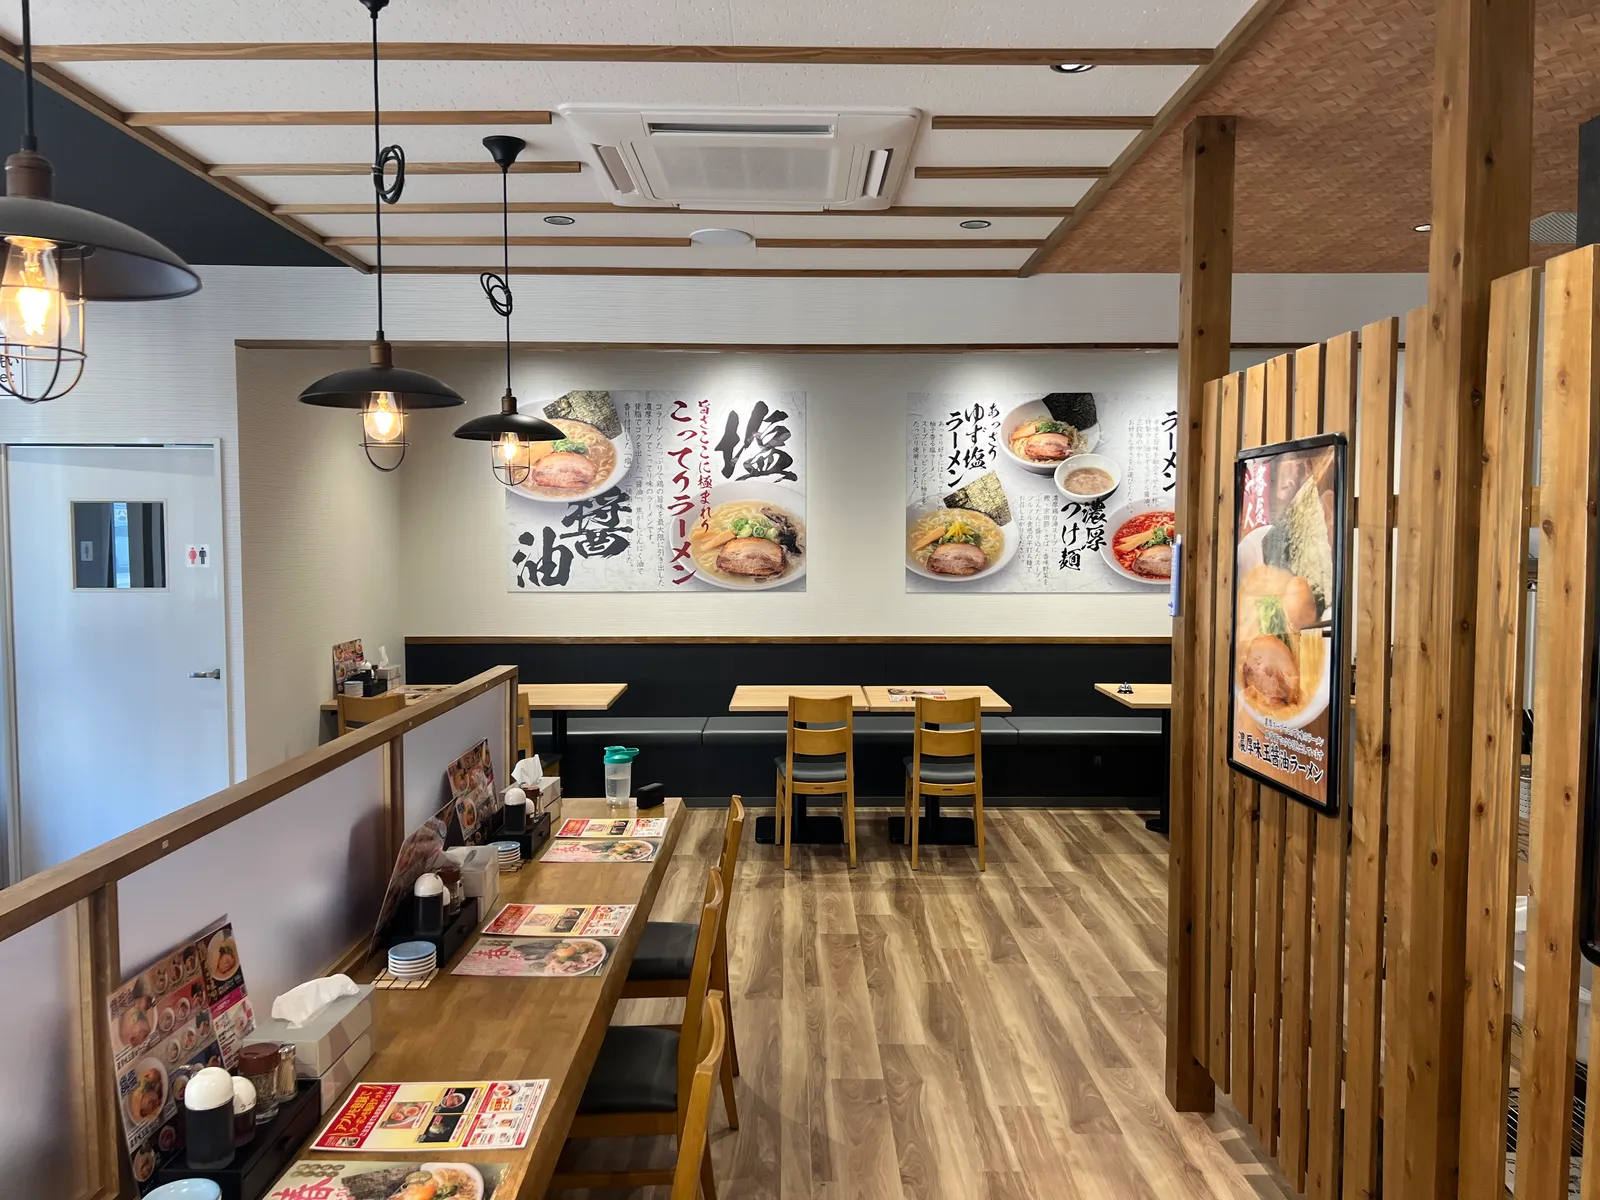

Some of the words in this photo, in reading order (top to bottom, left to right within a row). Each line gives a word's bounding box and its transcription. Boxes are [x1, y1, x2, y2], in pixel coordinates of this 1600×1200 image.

[698, 399, 712, 534] 旨さここに極まれり
[714, 400, 798, 483] 塩
[945, 411, 965, 489] ラーメン
[962, 402, 987, 471] ゆず塩
[987, 402, 1001, 461] あっさり
[1161, 410, 1177, 492] ラーメン
[667, 400, 698, 585] こってりラーメン
[1081, 498, 1108, 552] 濃厚
[1059, 501, 1081, 571] つけ麺
[1238, 730, 1324, 784] 濃厚味玉醤油ラーメン
